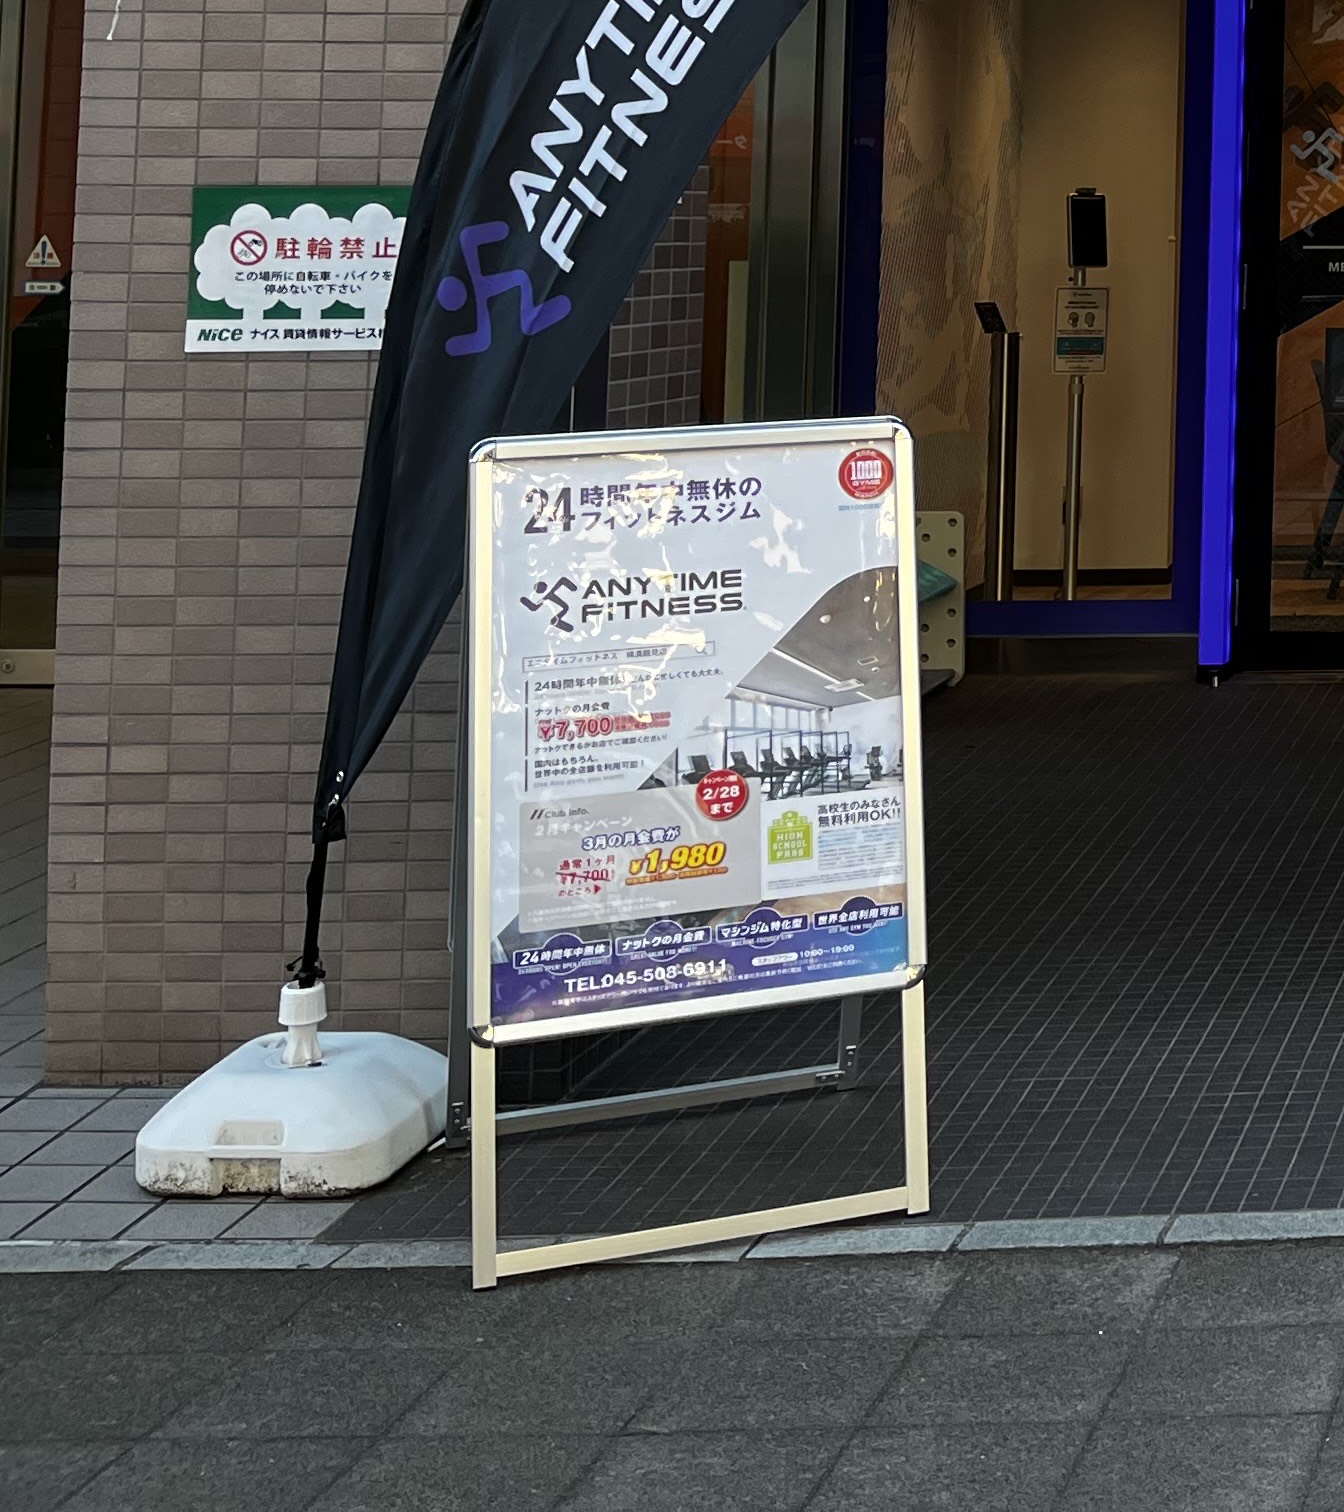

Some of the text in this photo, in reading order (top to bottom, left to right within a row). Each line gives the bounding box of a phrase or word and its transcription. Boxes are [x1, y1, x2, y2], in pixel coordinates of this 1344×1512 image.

[275, 237, 397, 260] 駐輪禁止
[234, 270, 393, 282] この場所に自転車・バイクを
[264, 284, 362, 295] 停めないで下さい
[250, 328, 280, 340] ナイス
[581, 594, 744, 624] FITNESS
[702, 785, 740, 801] 2/28
[545, 809, 567, 819] Club
[710, 801, 734, 815] まで
[817, 796, 901, 815] 高校生のみなさん
[628, 840, 727, 875] ¥1,980
[720, 917, 804, 940] マシンジム特化型
[519, 943, 606, 966] 24時間年中無休
